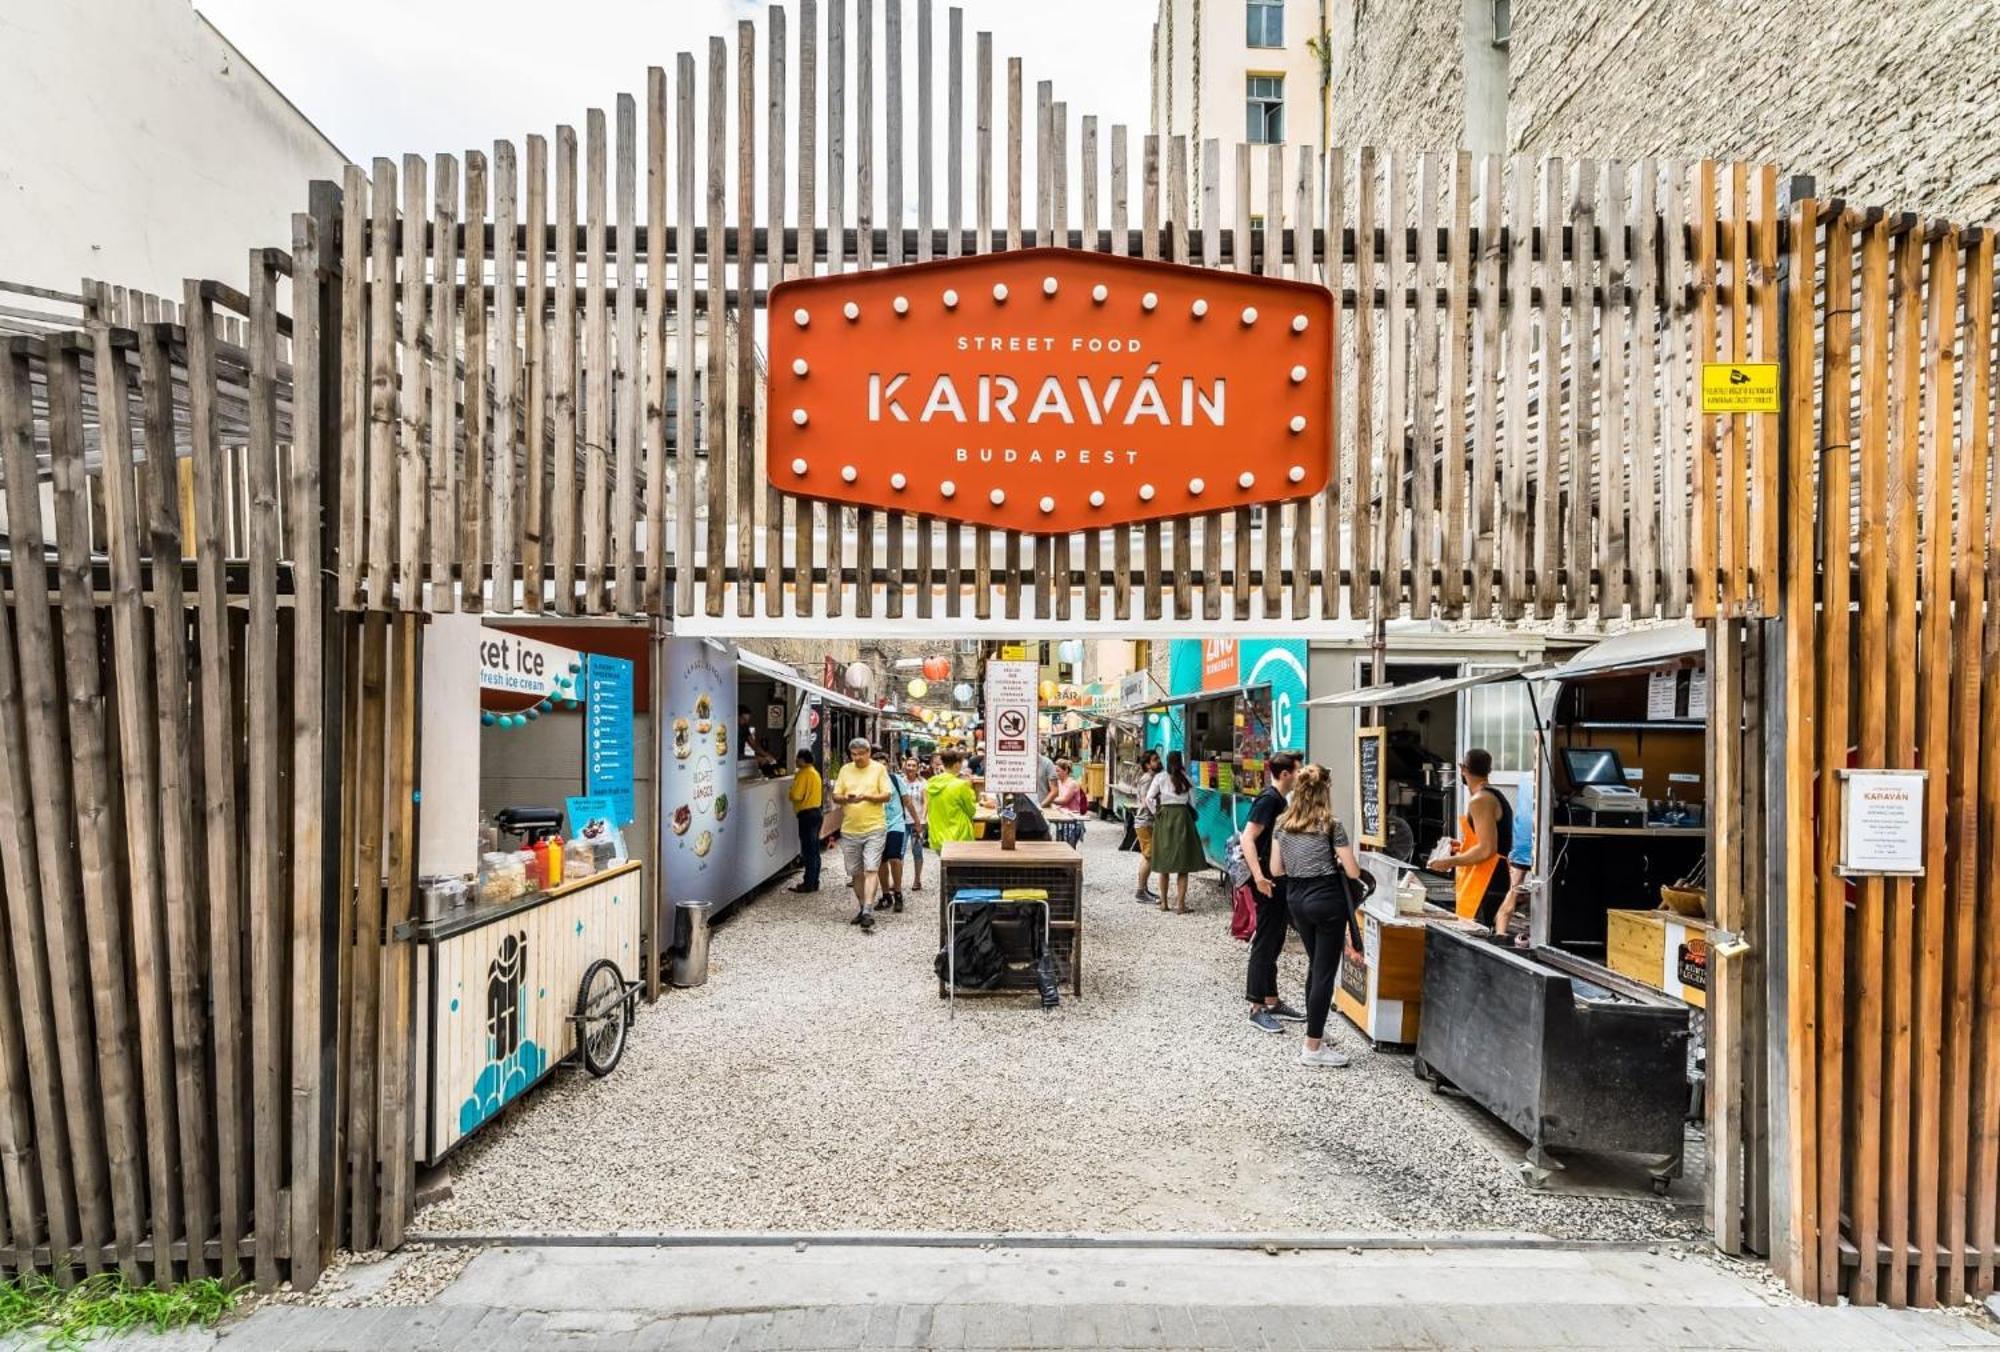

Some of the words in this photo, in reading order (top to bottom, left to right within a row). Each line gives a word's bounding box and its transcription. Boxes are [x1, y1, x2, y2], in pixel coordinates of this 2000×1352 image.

[957, 336, 1055, 352] STREET
[1072, 337, 1142, 353] FOOD
[868, 361, 1227, 427] KARAVÁN
[956, 447, 1139, 465] BUDAPEST
[517, 639, 544, 676] ice
[480, 669, 503, 686] fresh
[505, 673, 518, 688] ice
[520, 678, 545, 691] cream
